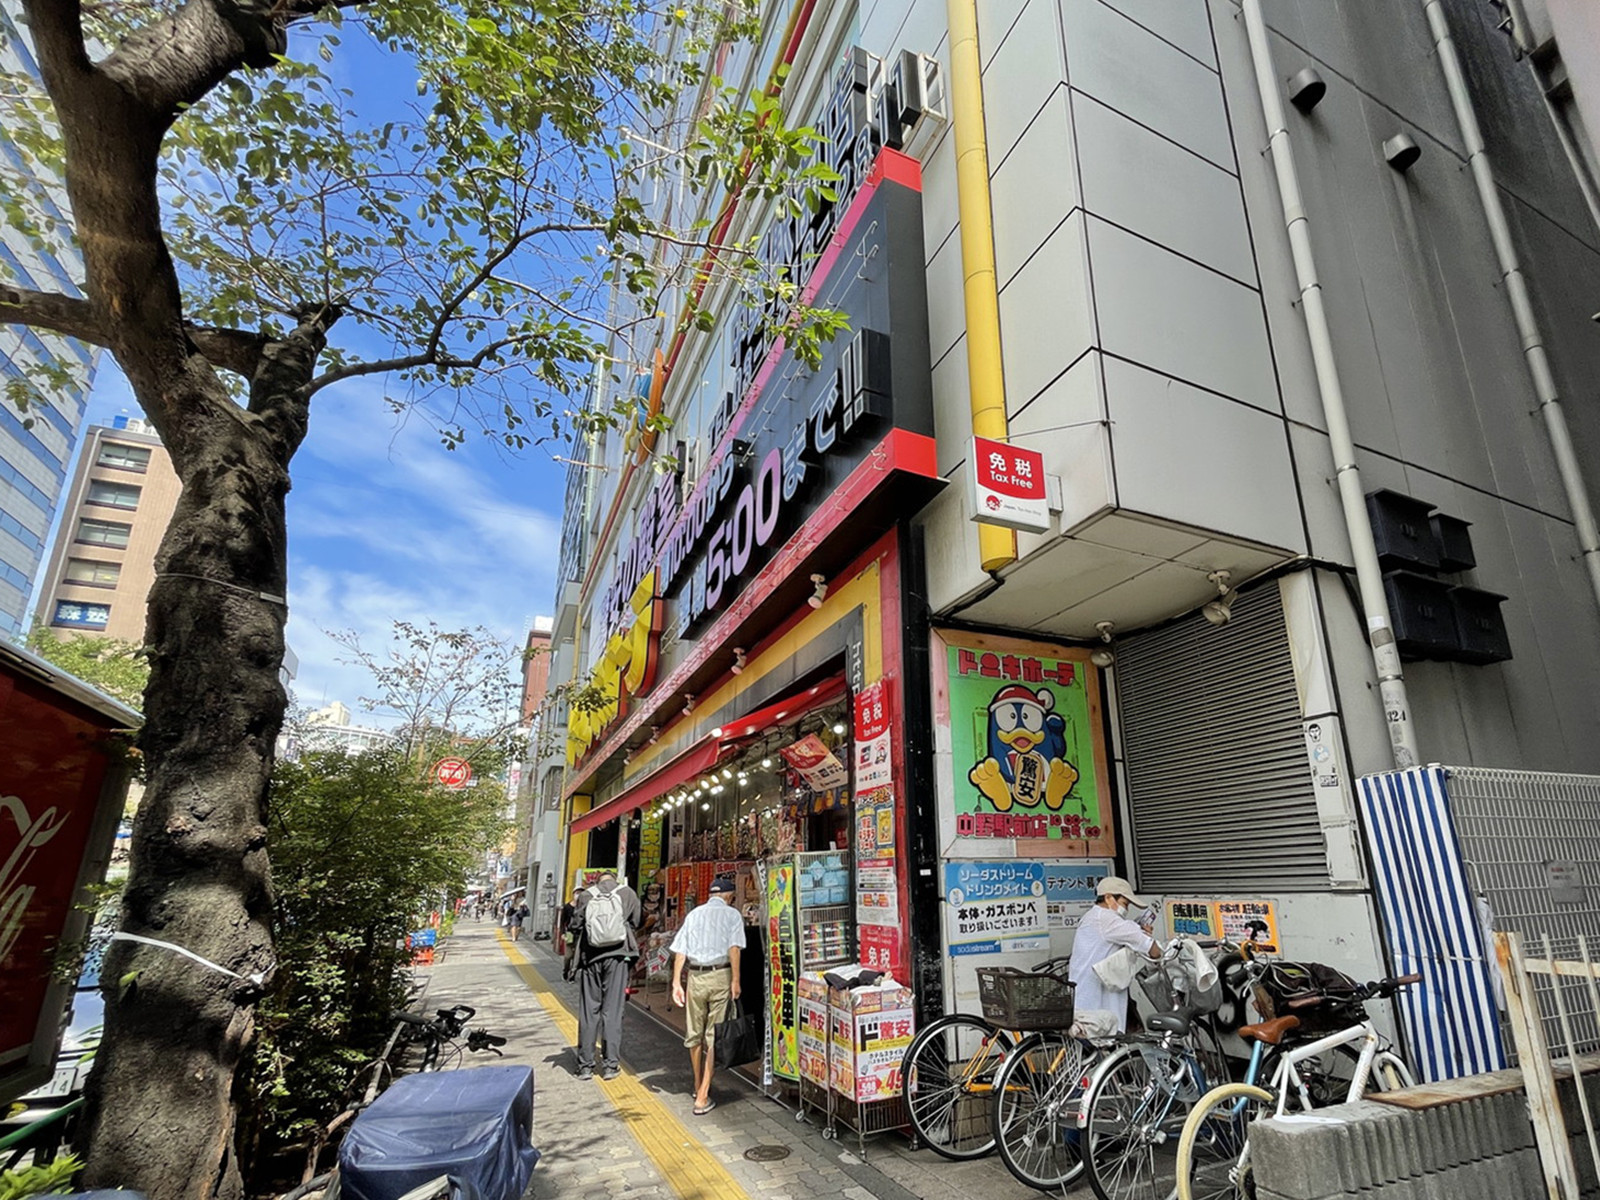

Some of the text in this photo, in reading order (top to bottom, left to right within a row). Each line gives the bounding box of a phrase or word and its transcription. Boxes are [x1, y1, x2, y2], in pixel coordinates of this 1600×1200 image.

[989, 452, 1032, 478] 免税
[990, 471, 1033, 489] Tax Free
[862, 700, 883, 725] 免税
[1018, 756, 1038, 799] 驚安
[956, 812, 1047, 838] 中野駅前店
[960, 868, 1033, 881] ソーダストリーム
[966, 882, 1029, 897] ドリンクメイト
[958, 902, 1037, 921] 本体・ガスボンベ
[868, 946, 891, 969] 免税
